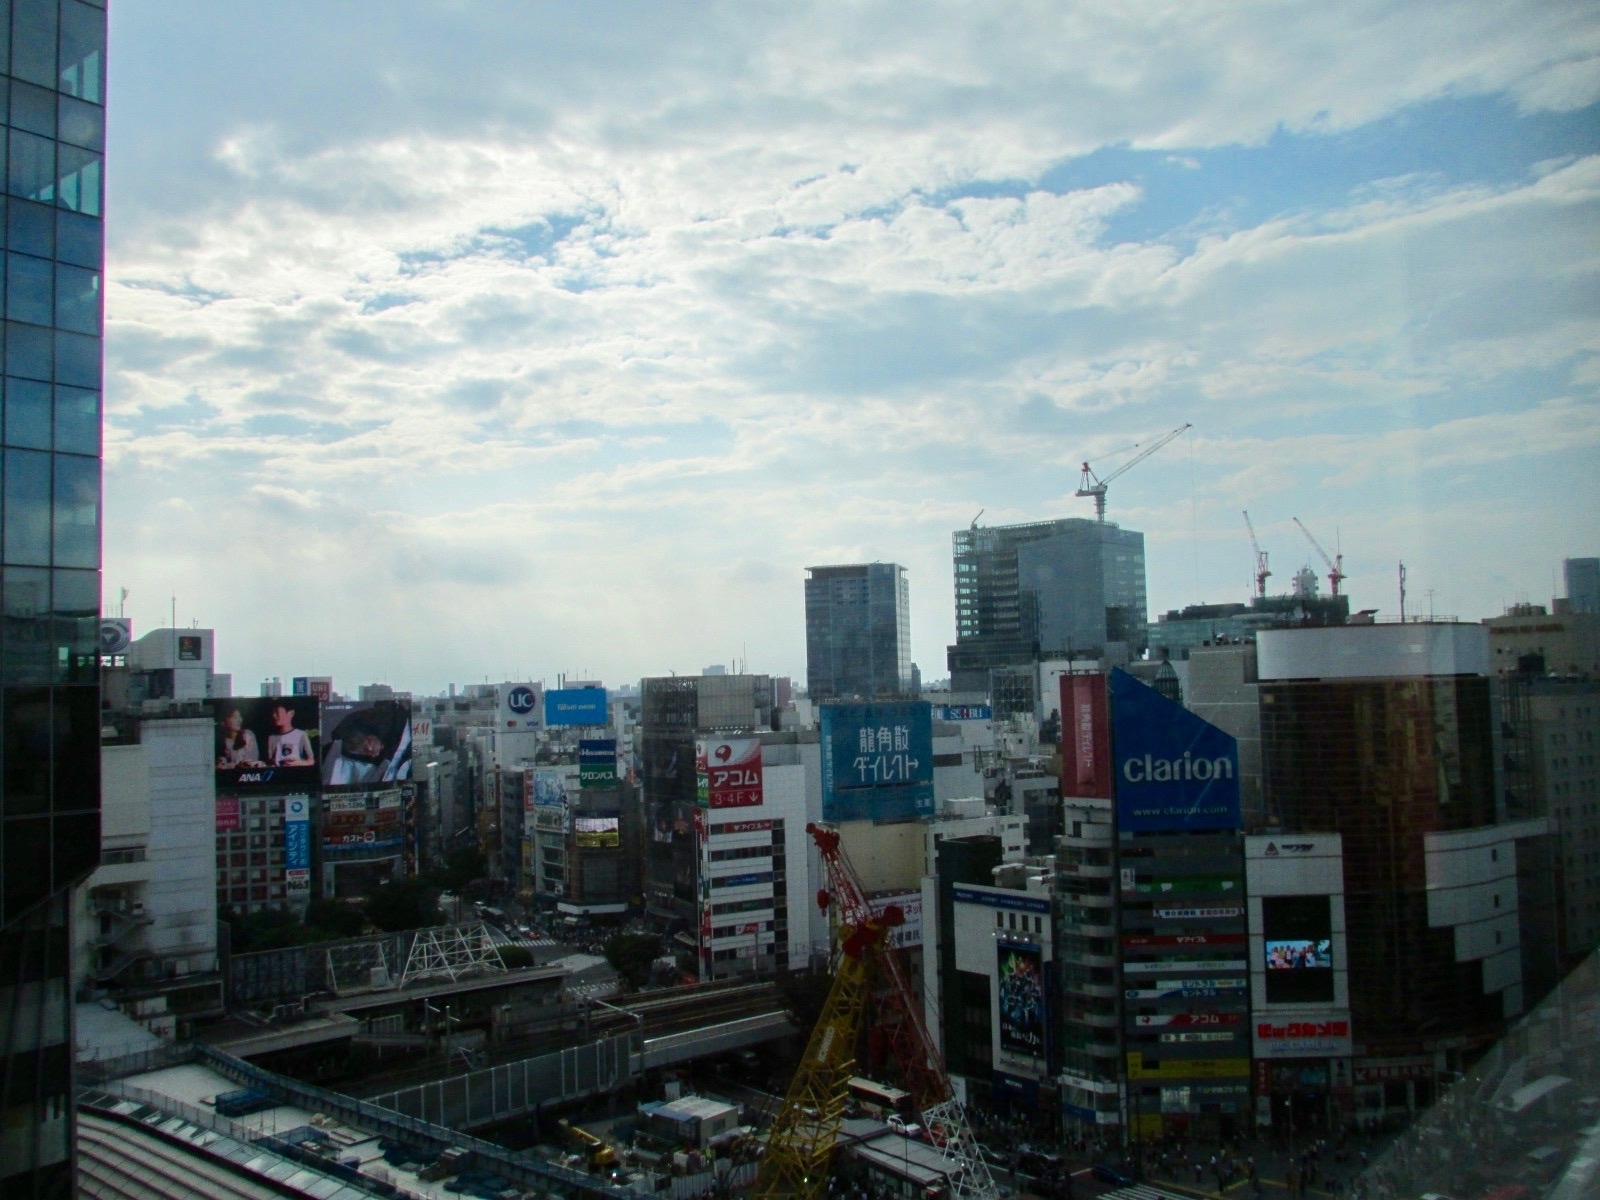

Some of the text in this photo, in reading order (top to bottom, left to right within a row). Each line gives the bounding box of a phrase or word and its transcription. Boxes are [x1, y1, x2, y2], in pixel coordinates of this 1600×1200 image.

[510, 693, 534, 708] UC
[950, 708, 982, 719] SEIBU
[859, 725, 909, 753] 龍角散
[853, 754, 919, 782] ダイレクト
[1123, 750, 1233, 782] clarion
[239, 772, 261, 783] ANA
[581, 771, 614, 780] サロンパス
[713, 769, 758, 788] アコム
[288, 824, 298, 866] アイシティ
[1182, 989, 1216, 997] セントラル
[1190, 1015, 1219, 1024] アコム
[1257, 1021, 1348, 1039] ビックカメラ
